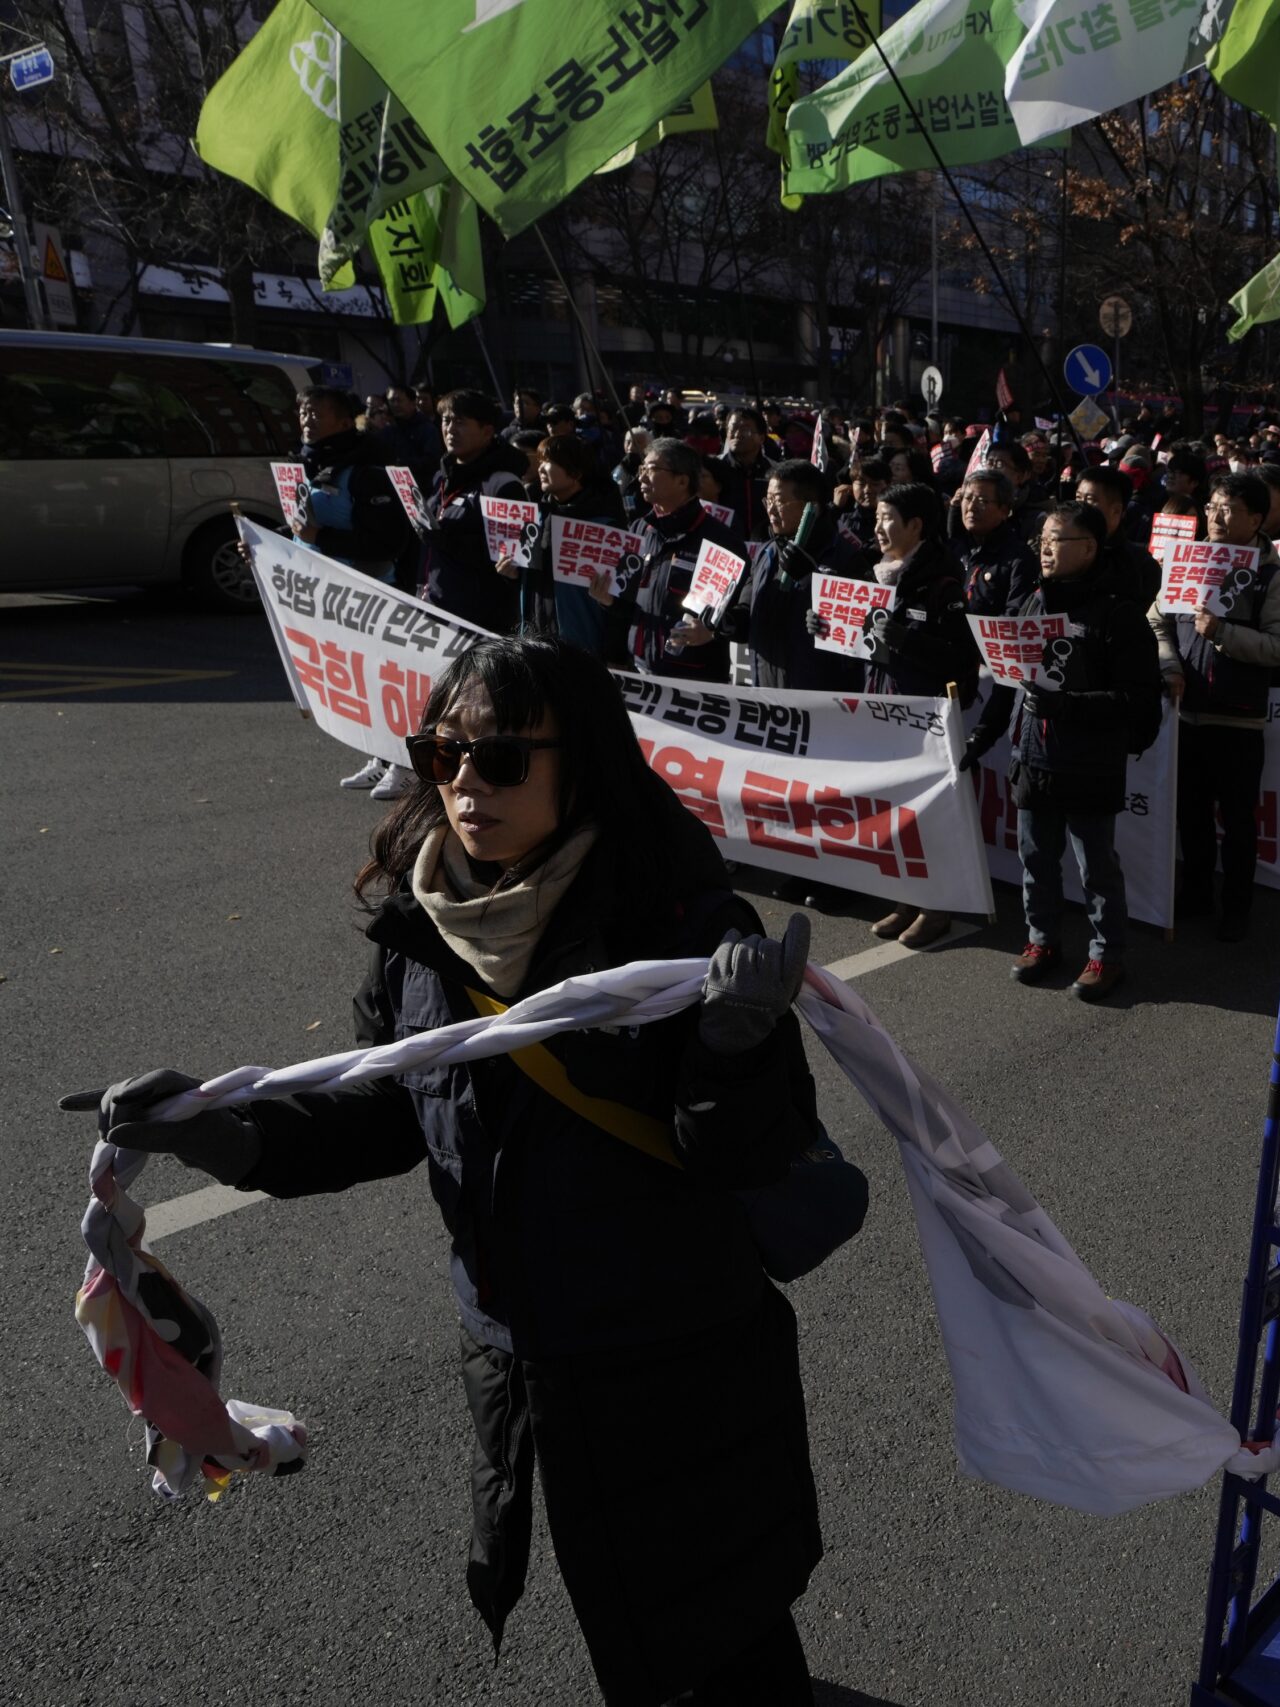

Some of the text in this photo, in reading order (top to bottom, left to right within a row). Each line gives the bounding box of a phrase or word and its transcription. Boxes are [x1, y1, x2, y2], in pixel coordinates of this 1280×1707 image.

[486, 500, 535, 524] 내란수괴
[703, 504, 729, 526] 수괴
[488, 520, 523, 540] 윤석열
[562, 520, 642, 554] 내란수괴
[559, 540, 621, 567] 윤석열
[704, 546, 745, 580] 내란수괴
[1172, 544, 1256, 570] 내란수괴
[697, 565, 731, 597] 윤석열
[1168, 566, 1228, 587] 윤석열
[819, 578, 892, 609] 내란수괴
[817, 602, 867, 627] 윤석열
[978, 617, 1066, 641] 내란수괴
[271, 564, 321, 618] 헌법
[322, 584, 389, 636] 파괴!
[382, 602, 441, 653] 민주
[662, 687, 732, 735] 노동
[734, 698, 811, 757] 탄압!
[984, 641, 1044, 664] 윤석열
[865, 700, 947, 738] 민주노총
[285, 626, 372, 729] 국힘
[379, 659, 432, 738] 해
[637, 737, 728, 839] 열
[740, 769, 929, 880] 탄핵!
